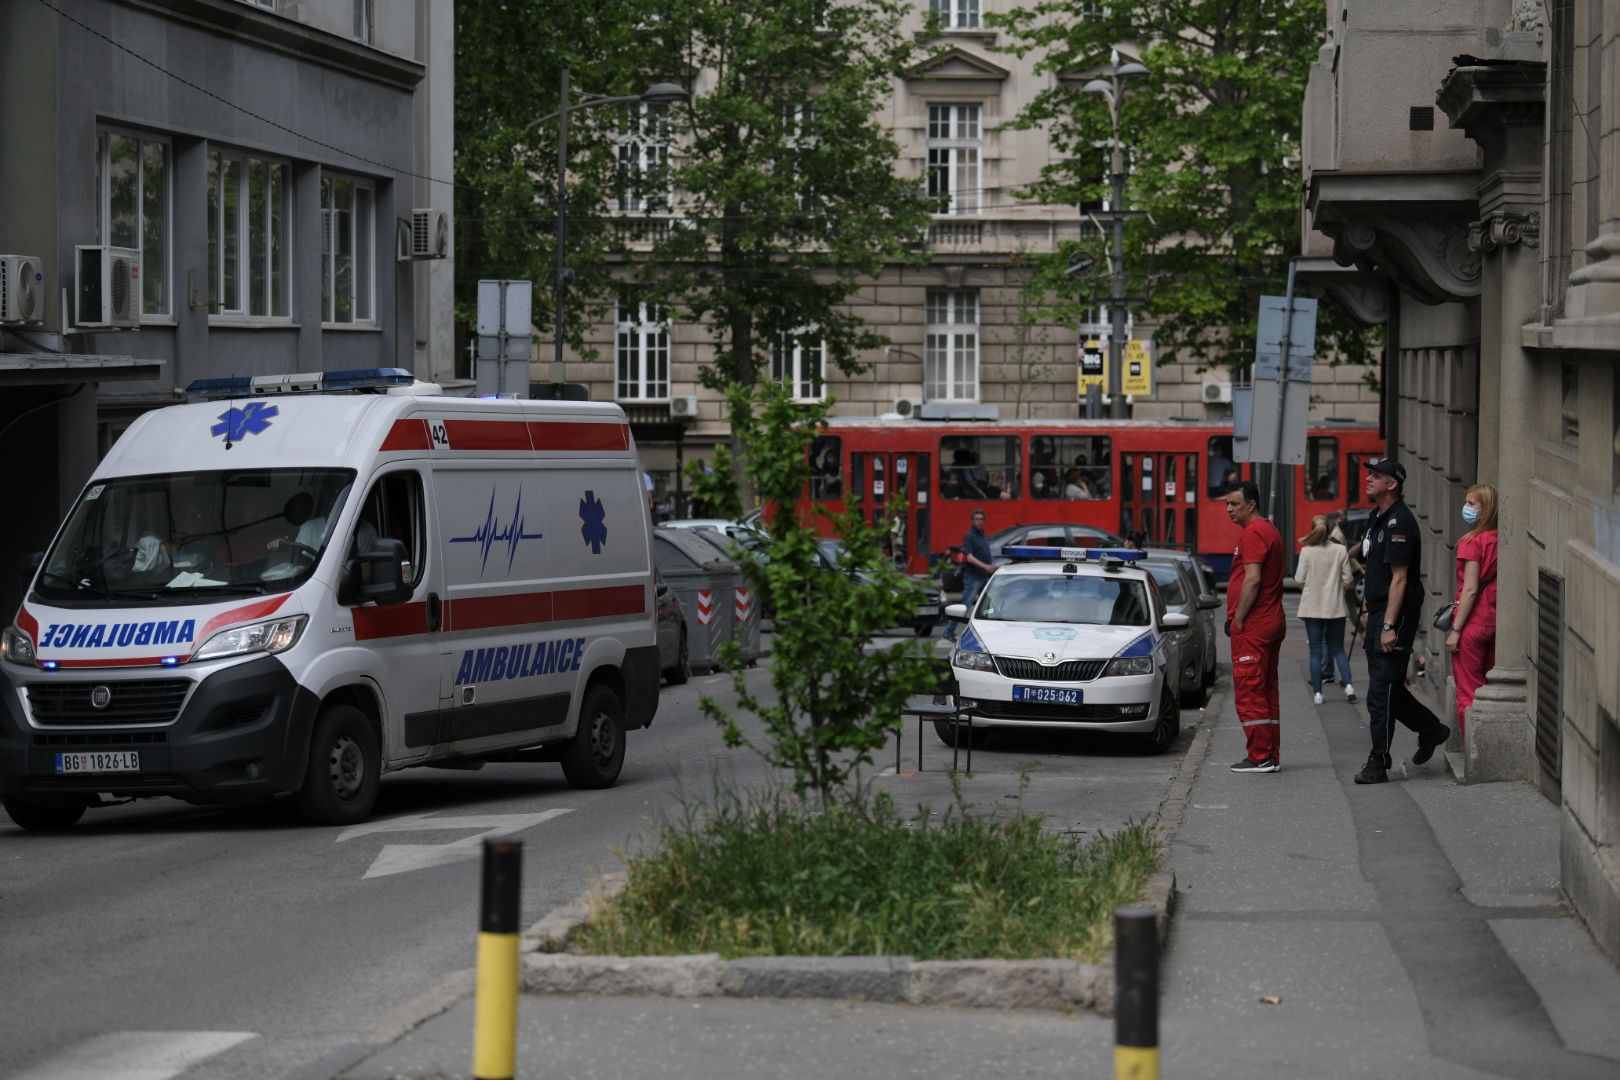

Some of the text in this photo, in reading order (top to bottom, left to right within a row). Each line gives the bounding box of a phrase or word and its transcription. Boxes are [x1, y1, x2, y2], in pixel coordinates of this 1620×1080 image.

[1084, 354, 1101, 365] BIG
[433, 425, 448, 444] 42
[455, 638, 586, 686] AMBULANCE
[95, 692, 107, 703] FIAT
[64, 755, 80, 771] BG
